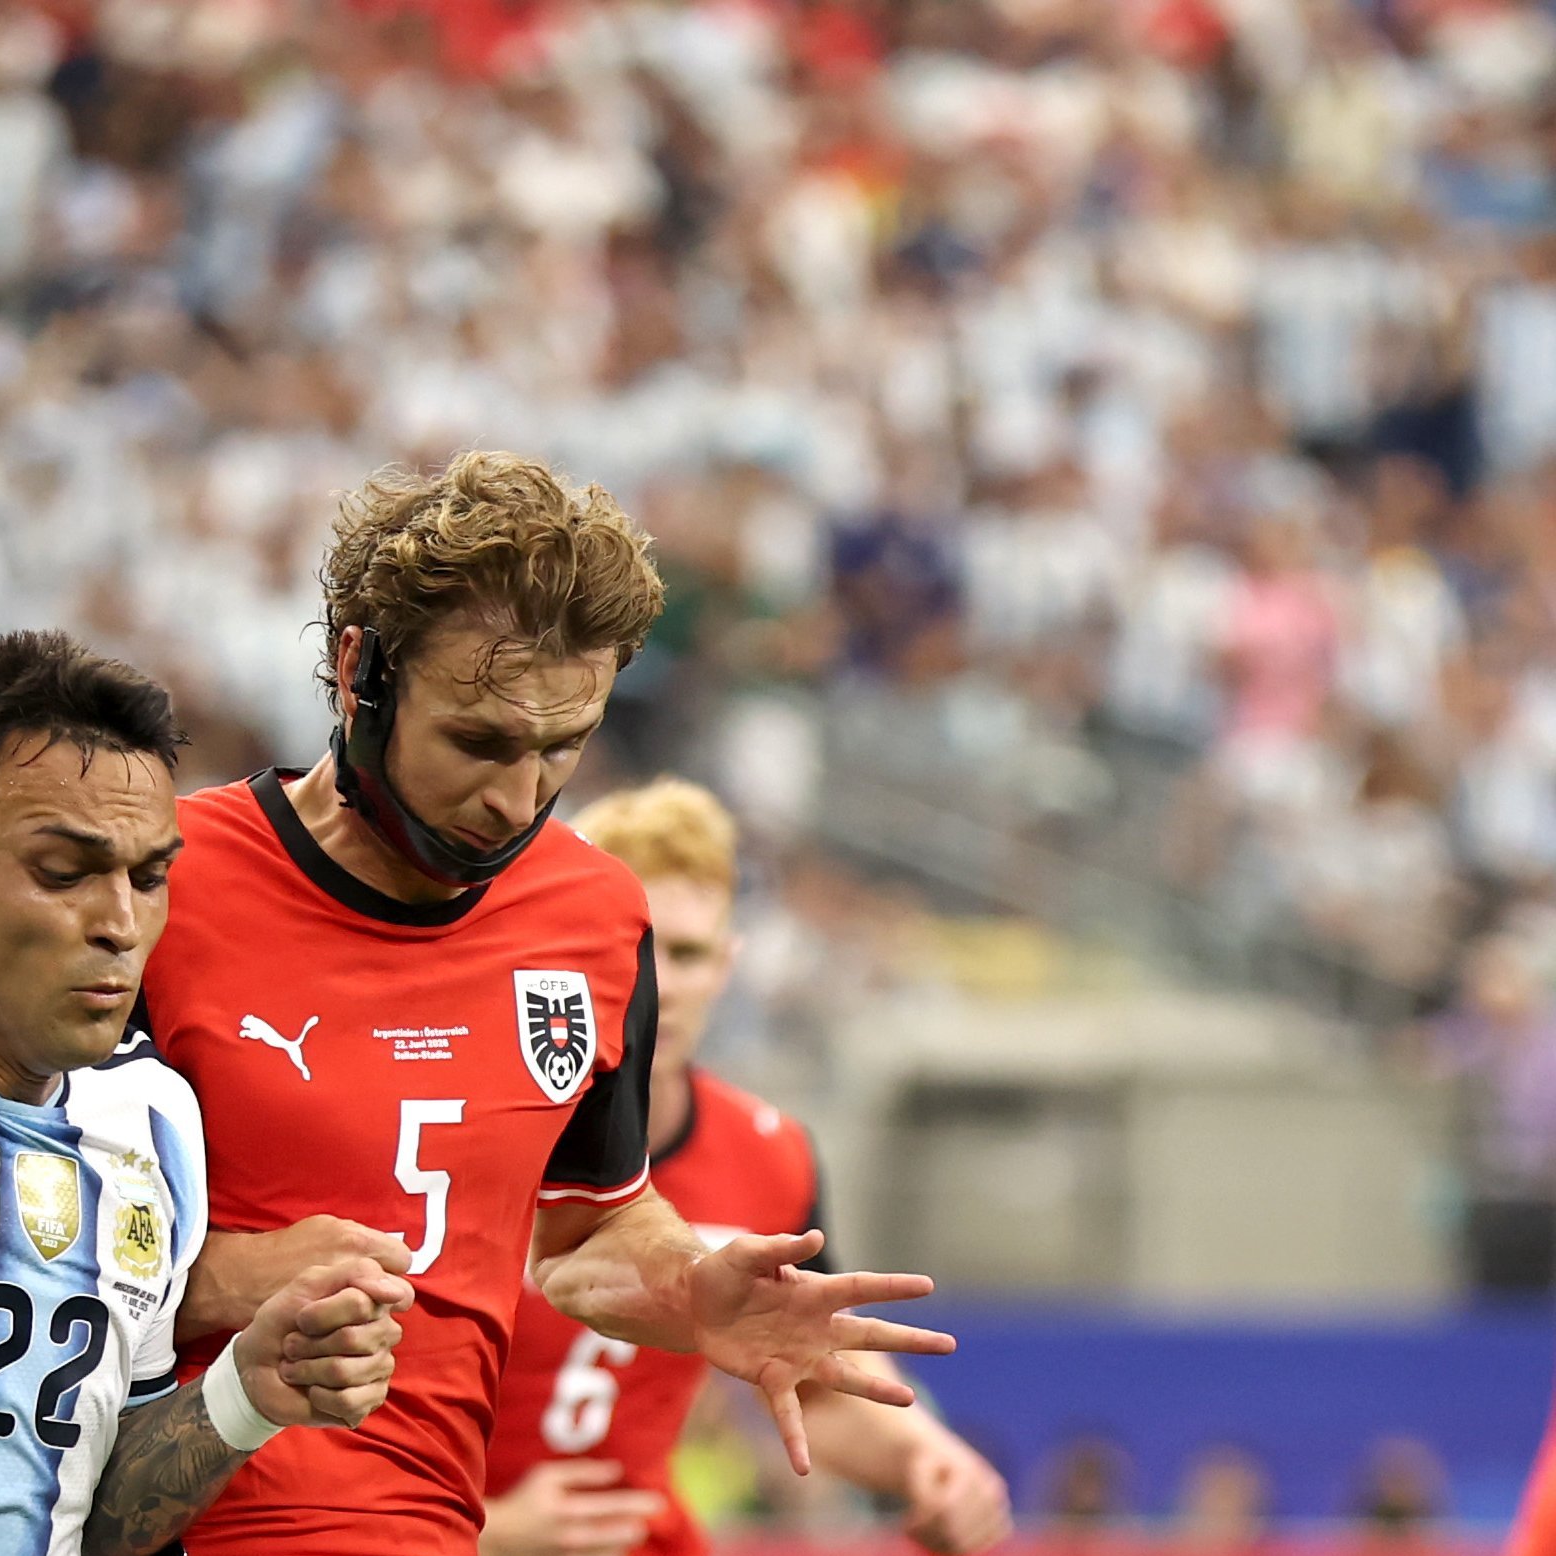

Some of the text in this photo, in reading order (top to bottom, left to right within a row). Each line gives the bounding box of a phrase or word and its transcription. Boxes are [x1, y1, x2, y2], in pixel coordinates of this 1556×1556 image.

[37, 1218, 67, 1237] FIFA
[386, 1099, 467, 1274] 5
[541, 1327, 638, 1455] 6
